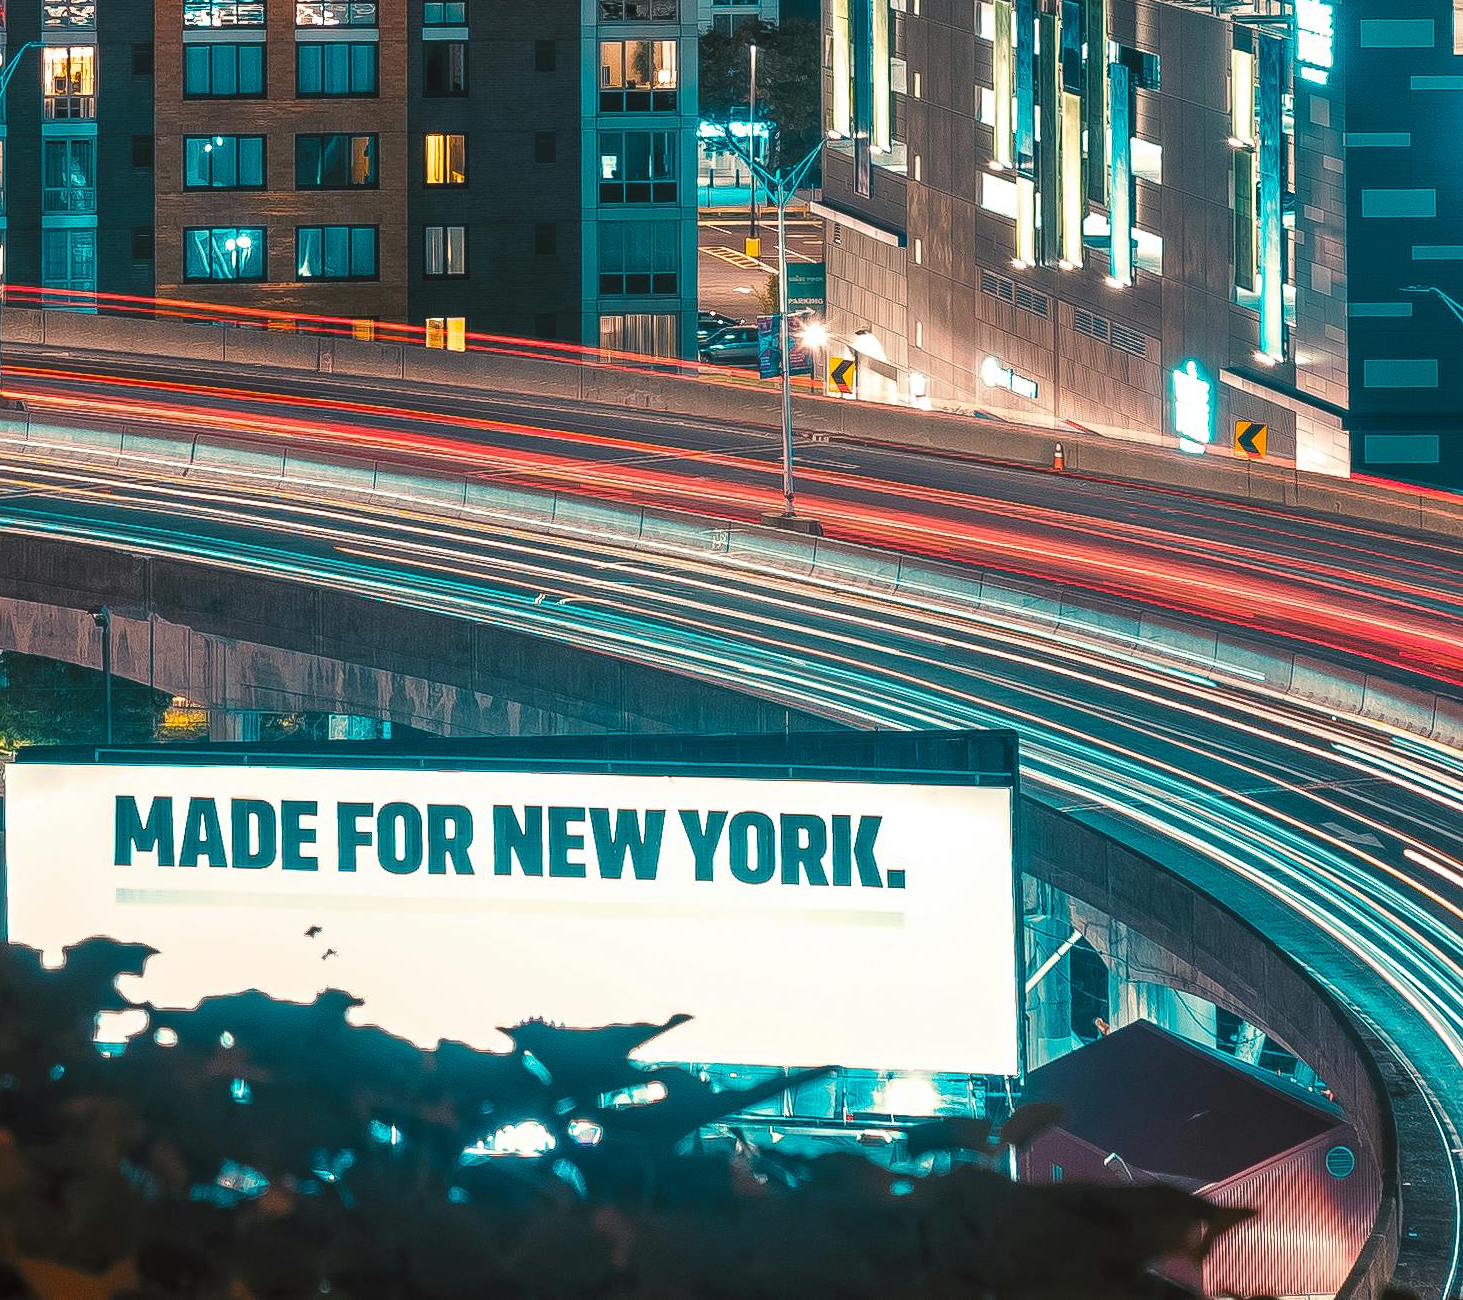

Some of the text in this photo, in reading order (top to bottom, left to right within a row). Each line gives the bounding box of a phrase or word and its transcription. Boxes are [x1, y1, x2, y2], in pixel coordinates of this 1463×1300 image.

[787, 297, 824, 305] PARKING
[114, 795, 905, 889] MADE FOR NEW YORK.
